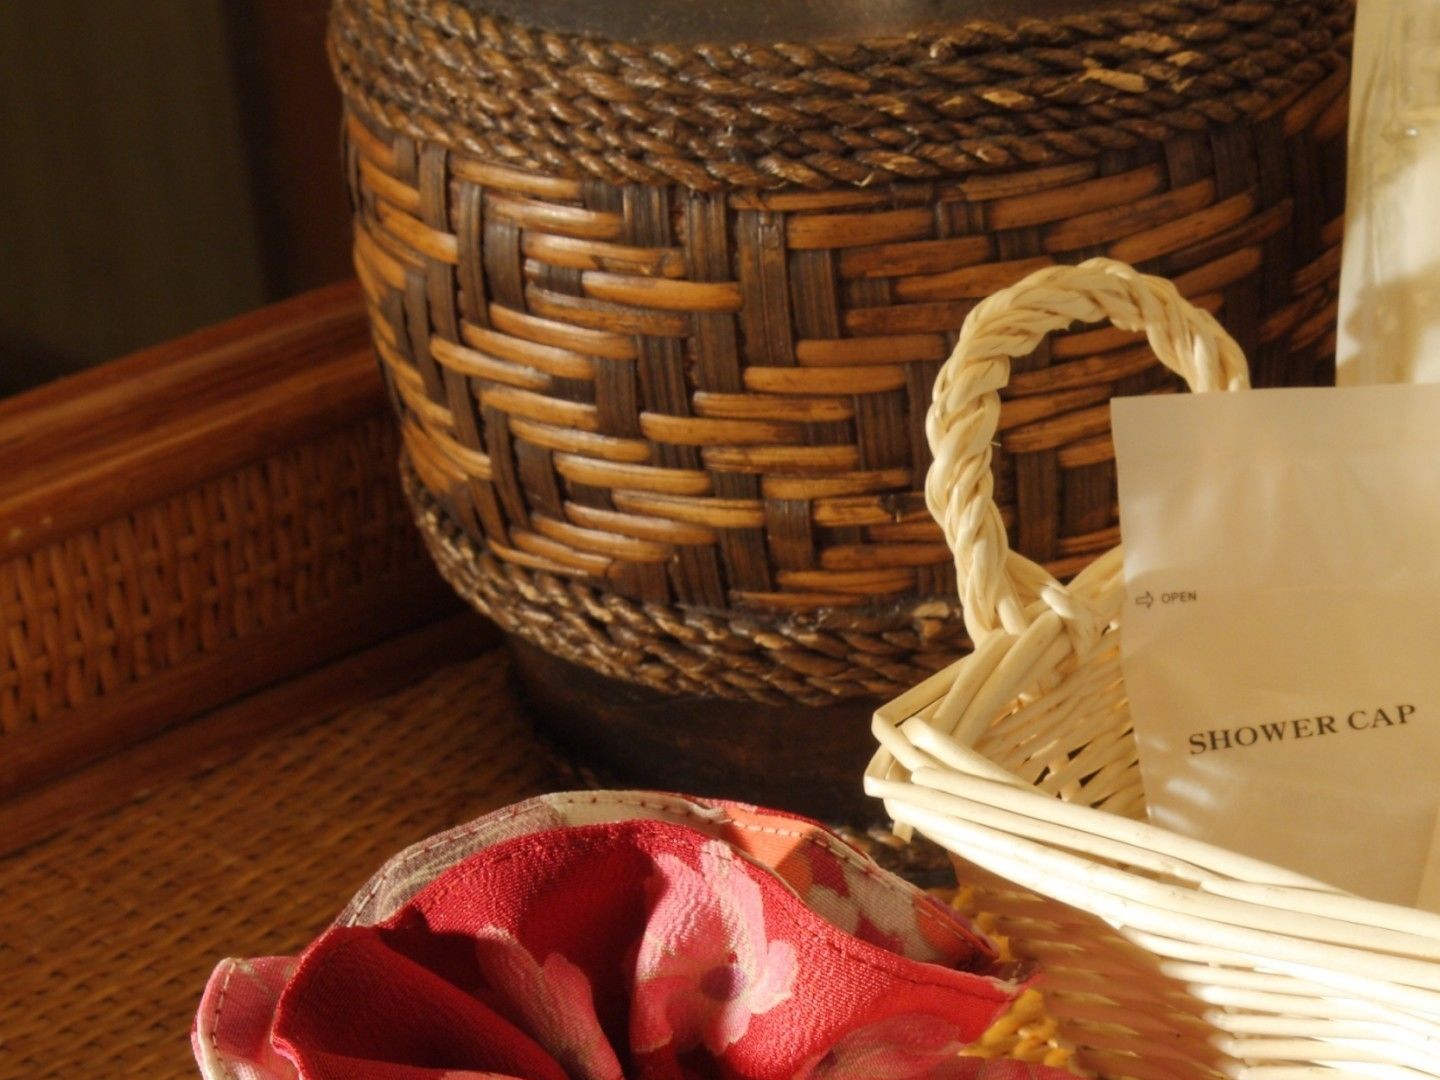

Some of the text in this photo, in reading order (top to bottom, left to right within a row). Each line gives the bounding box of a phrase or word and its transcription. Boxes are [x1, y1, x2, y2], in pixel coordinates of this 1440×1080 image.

[1161, 591, 1197, 604] OPEN
[1189, 704, 1416, 756] SHOWER CAP
